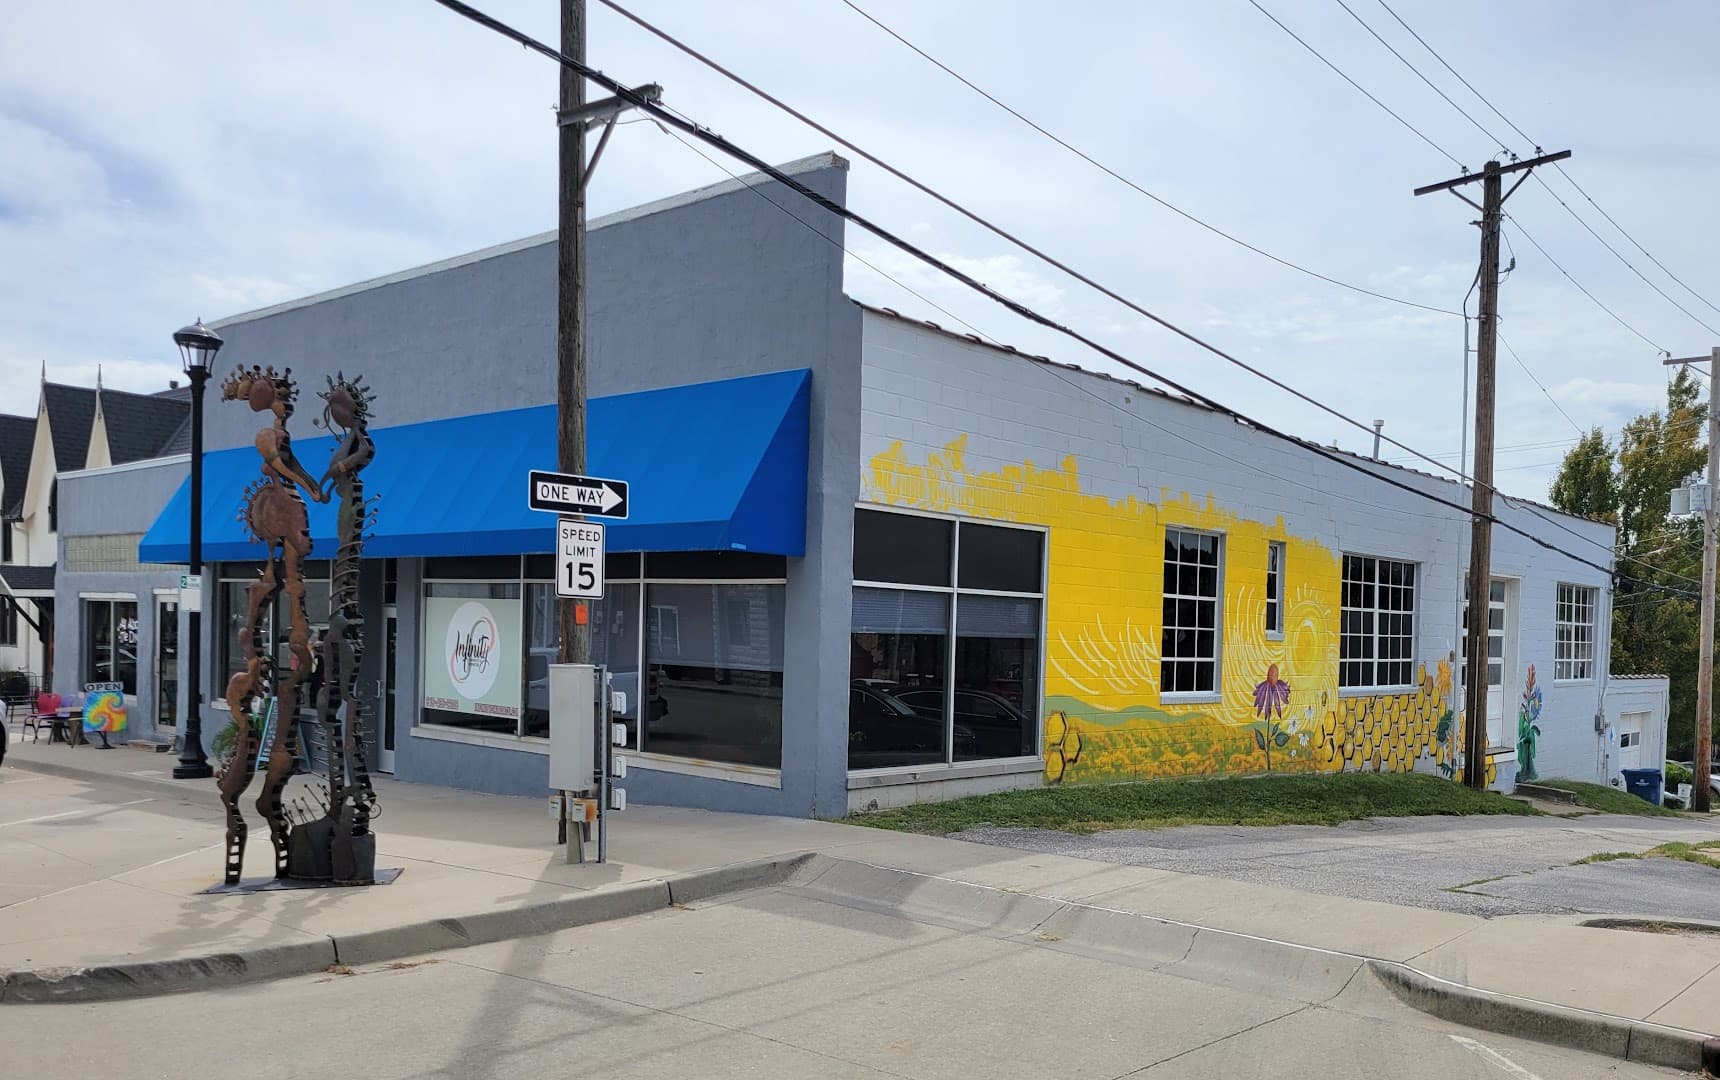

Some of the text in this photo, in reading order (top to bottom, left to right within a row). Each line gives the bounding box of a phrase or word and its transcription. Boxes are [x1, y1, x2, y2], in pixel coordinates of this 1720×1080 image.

[541, 484, 605, 504] ONE WAY
[562, 528, 601, 542] SPEED
[566, 545, 596, 557] LIMIT
[566, 562, 595, 590] 15
[455, 629, 490, 673] Infinity
[86, 683, 121, 691] OPEN
